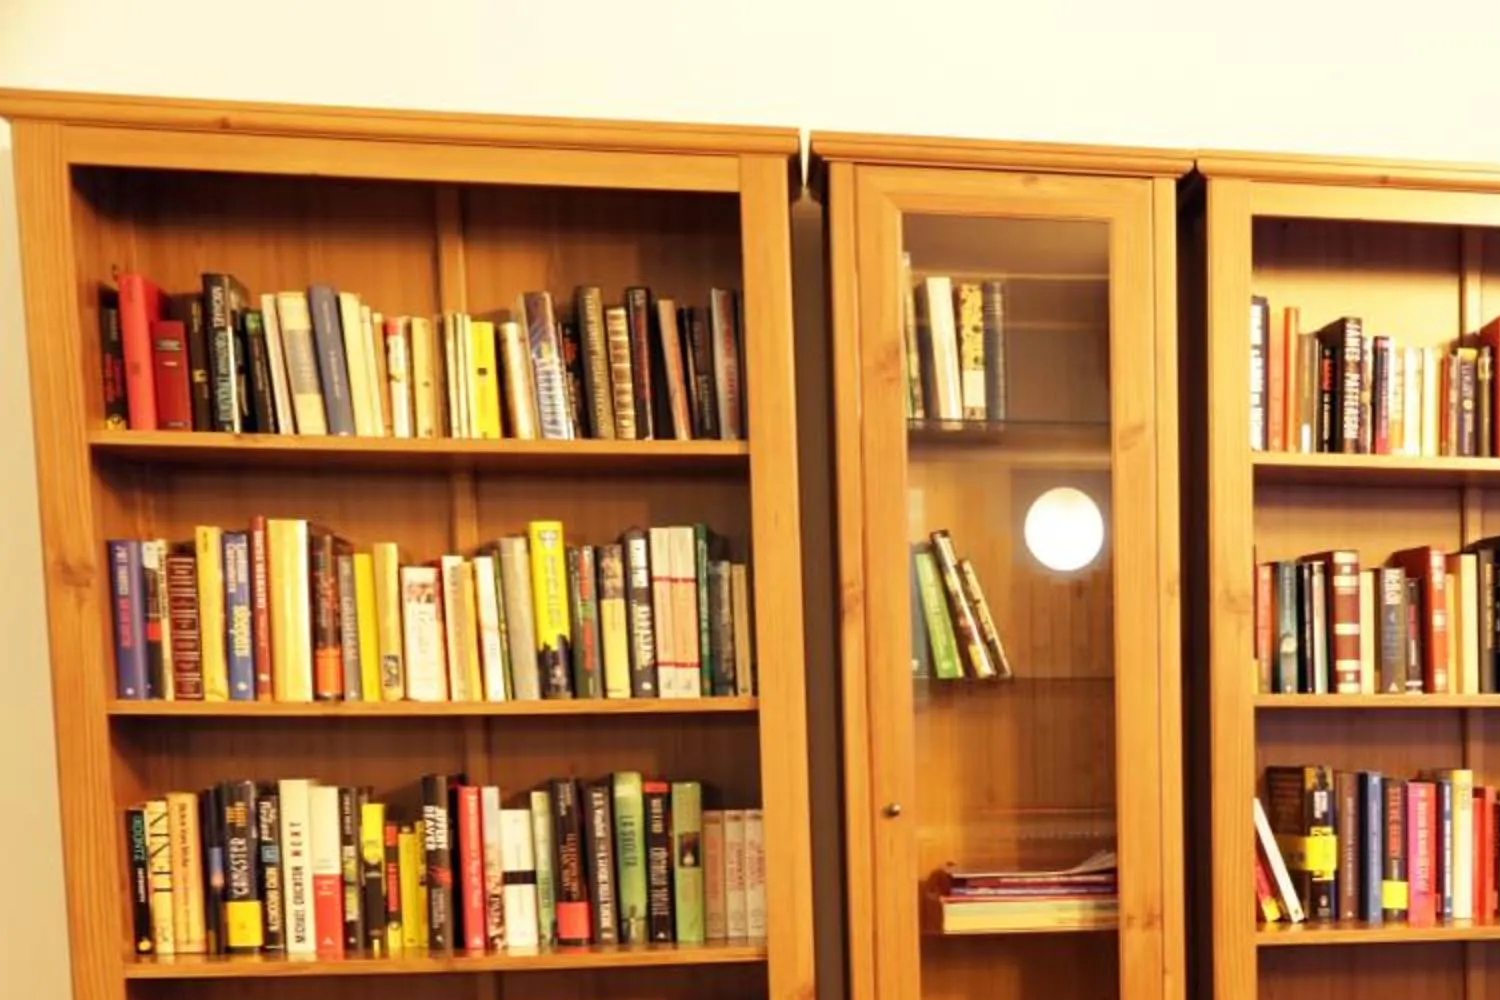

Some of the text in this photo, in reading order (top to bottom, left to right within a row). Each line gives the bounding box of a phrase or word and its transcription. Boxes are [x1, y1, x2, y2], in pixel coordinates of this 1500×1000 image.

[1343, 321, 1362, 439] JAMES PATTERSON
[149, 810, 173, 893] LENIN
[423, 805, 436, 851] DEAVER
[230, 837, 251, 897] GANGSTER
[292, 866, 305, 905] CRICHTON
[293, 909, 305, 944] MICHAEL
